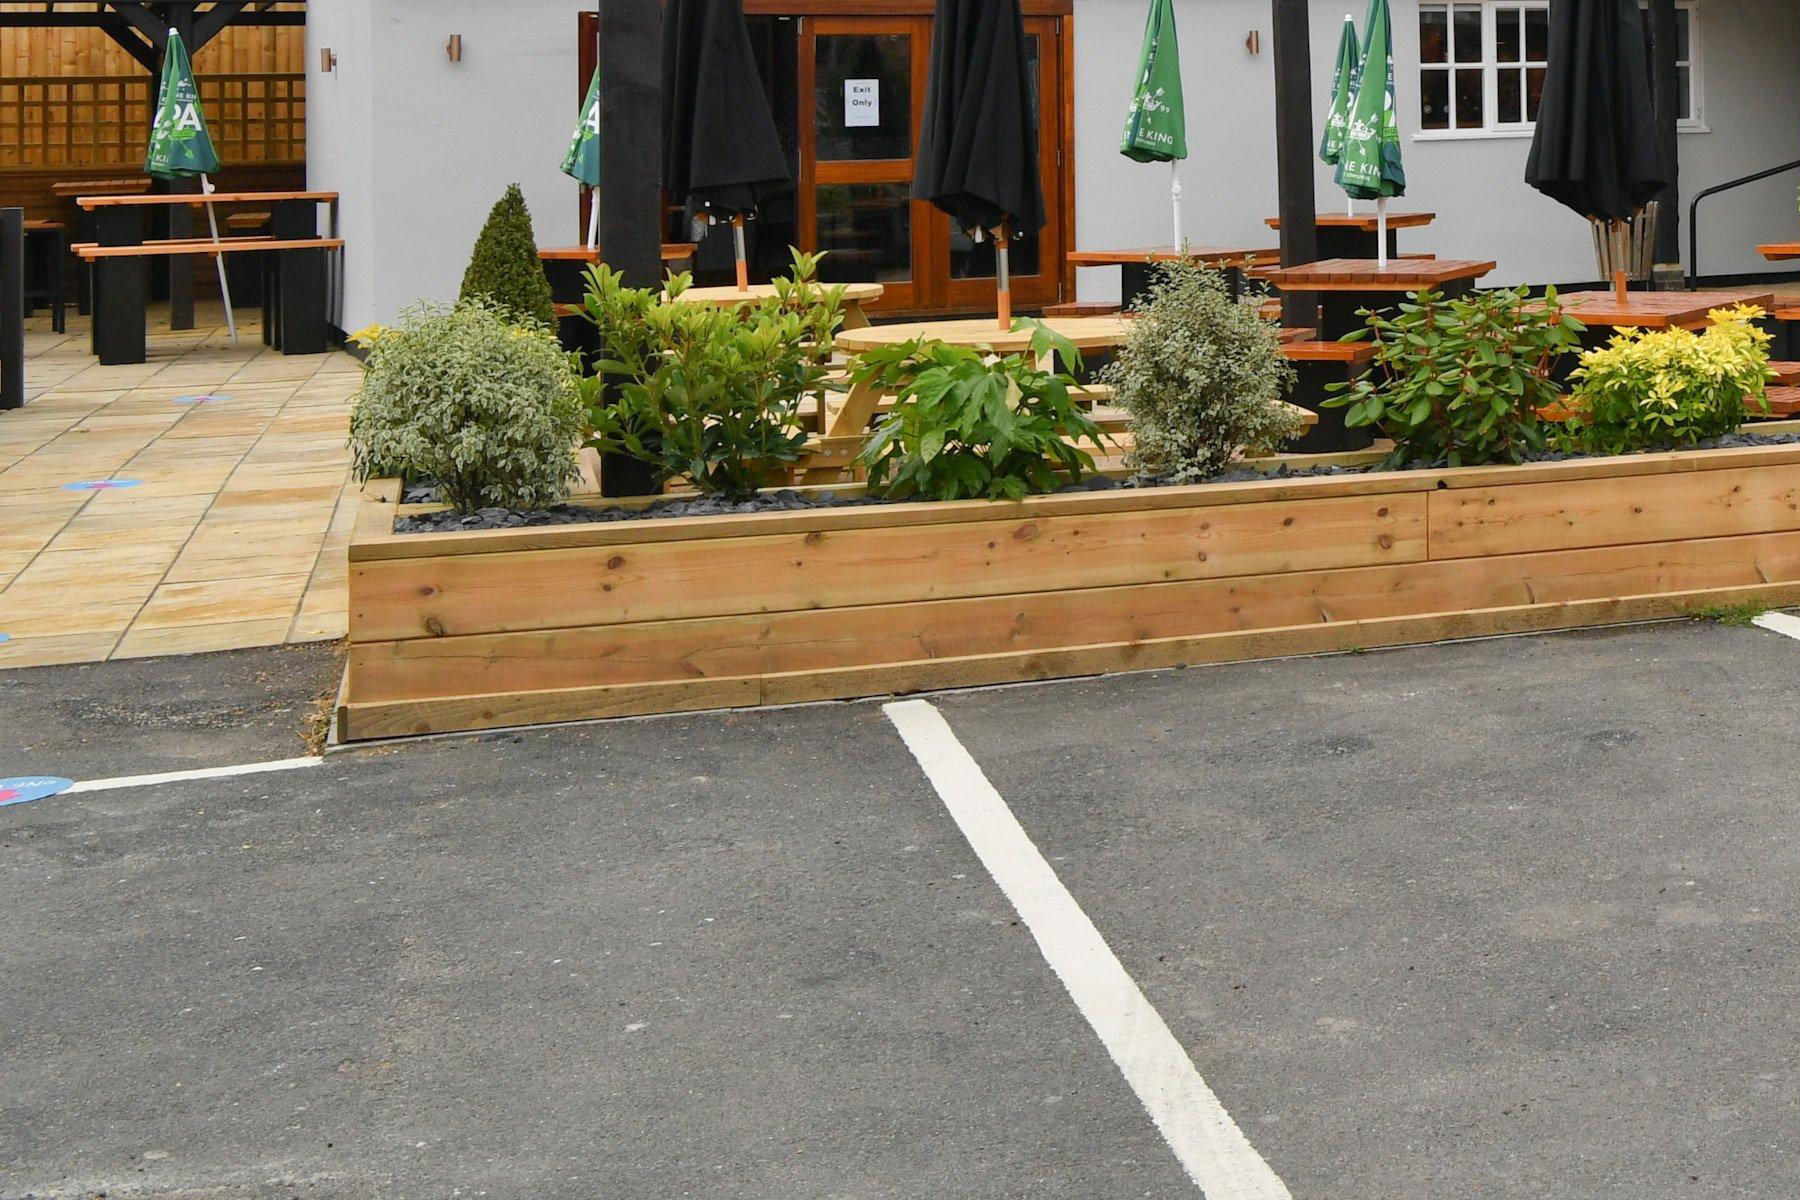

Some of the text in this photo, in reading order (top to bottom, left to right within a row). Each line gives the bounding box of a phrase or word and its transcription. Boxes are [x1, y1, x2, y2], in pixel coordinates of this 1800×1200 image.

[853, 86, 872, 94] Exit
[852, 99, 873, 107] Only
[1146, 129, 1174, 146] KING
[1360, 162, 1381, 178] KIN
